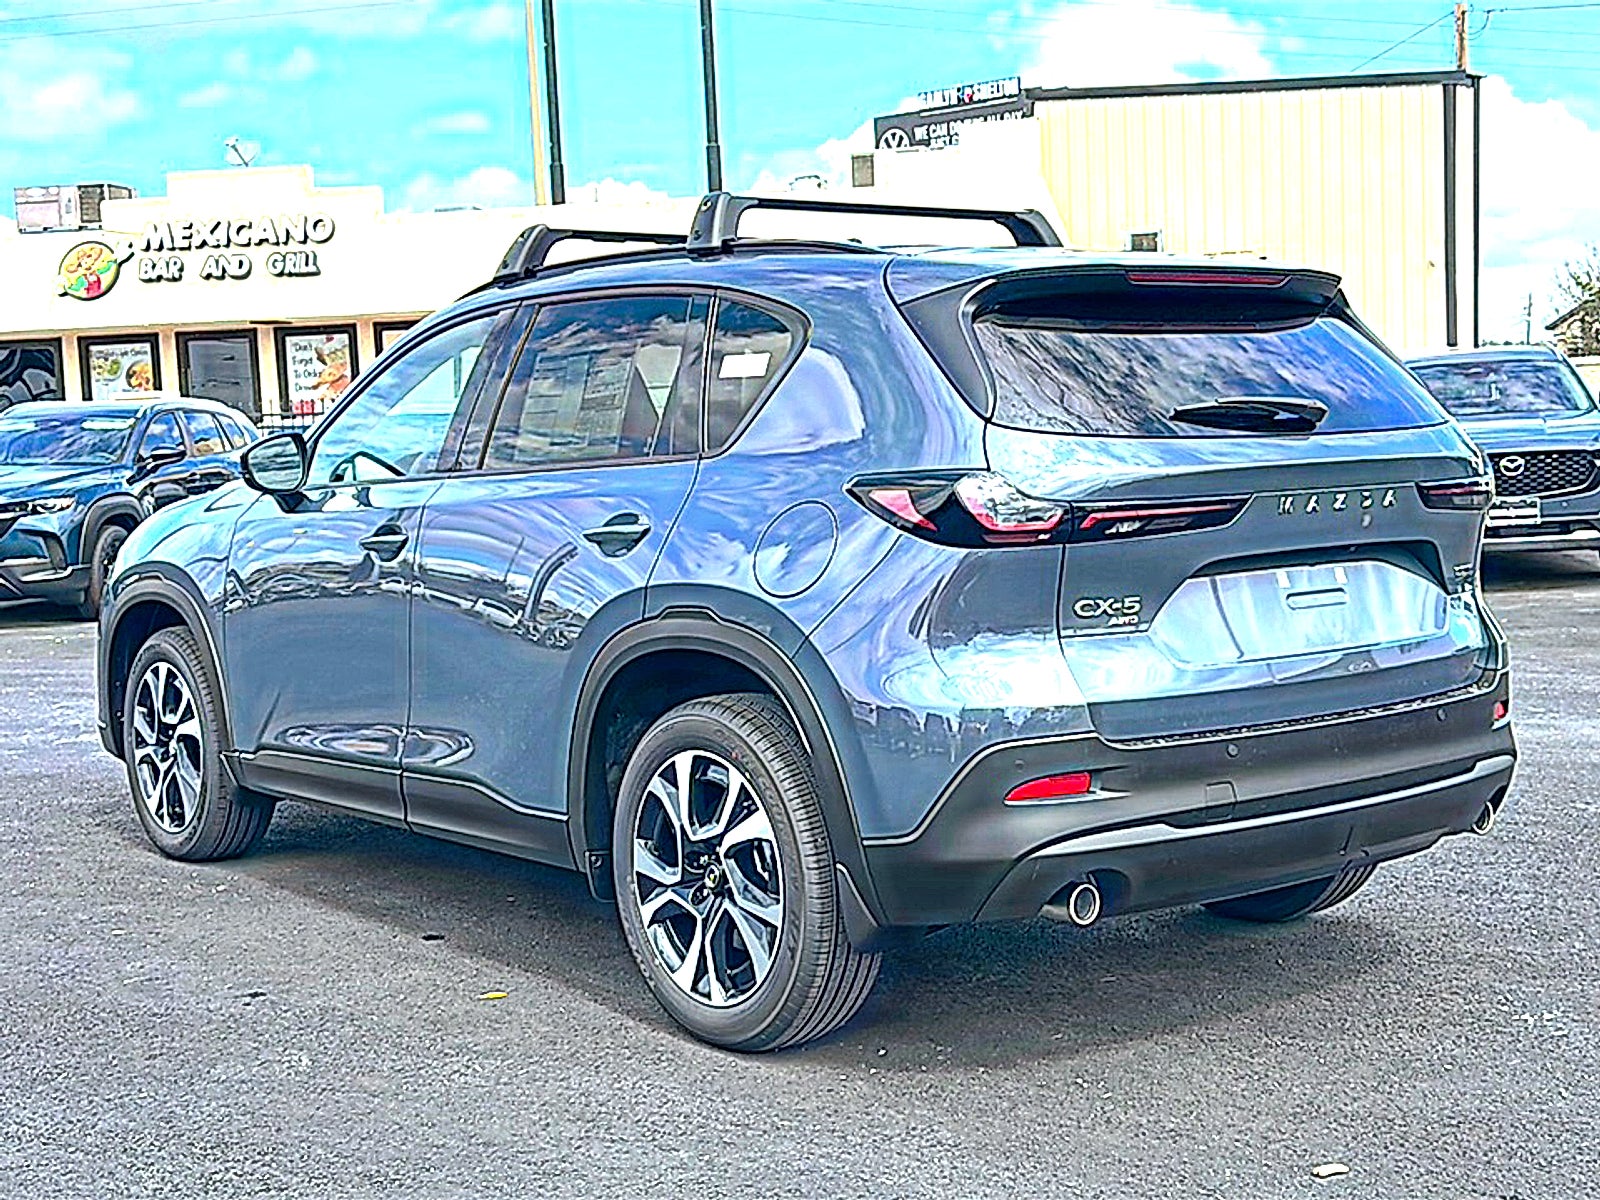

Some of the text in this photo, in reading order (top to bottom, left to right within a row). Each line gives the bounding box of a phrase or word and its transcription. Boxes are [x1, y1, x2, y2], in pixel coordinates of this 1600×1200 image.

[140, 215, 335, 252] MEXICANO
[139, 251, 321, 283] BAR AND GRILL
[1279, 490, 1397, 514] MAZDA
[1073, 596, 1143, 619] CX-5
